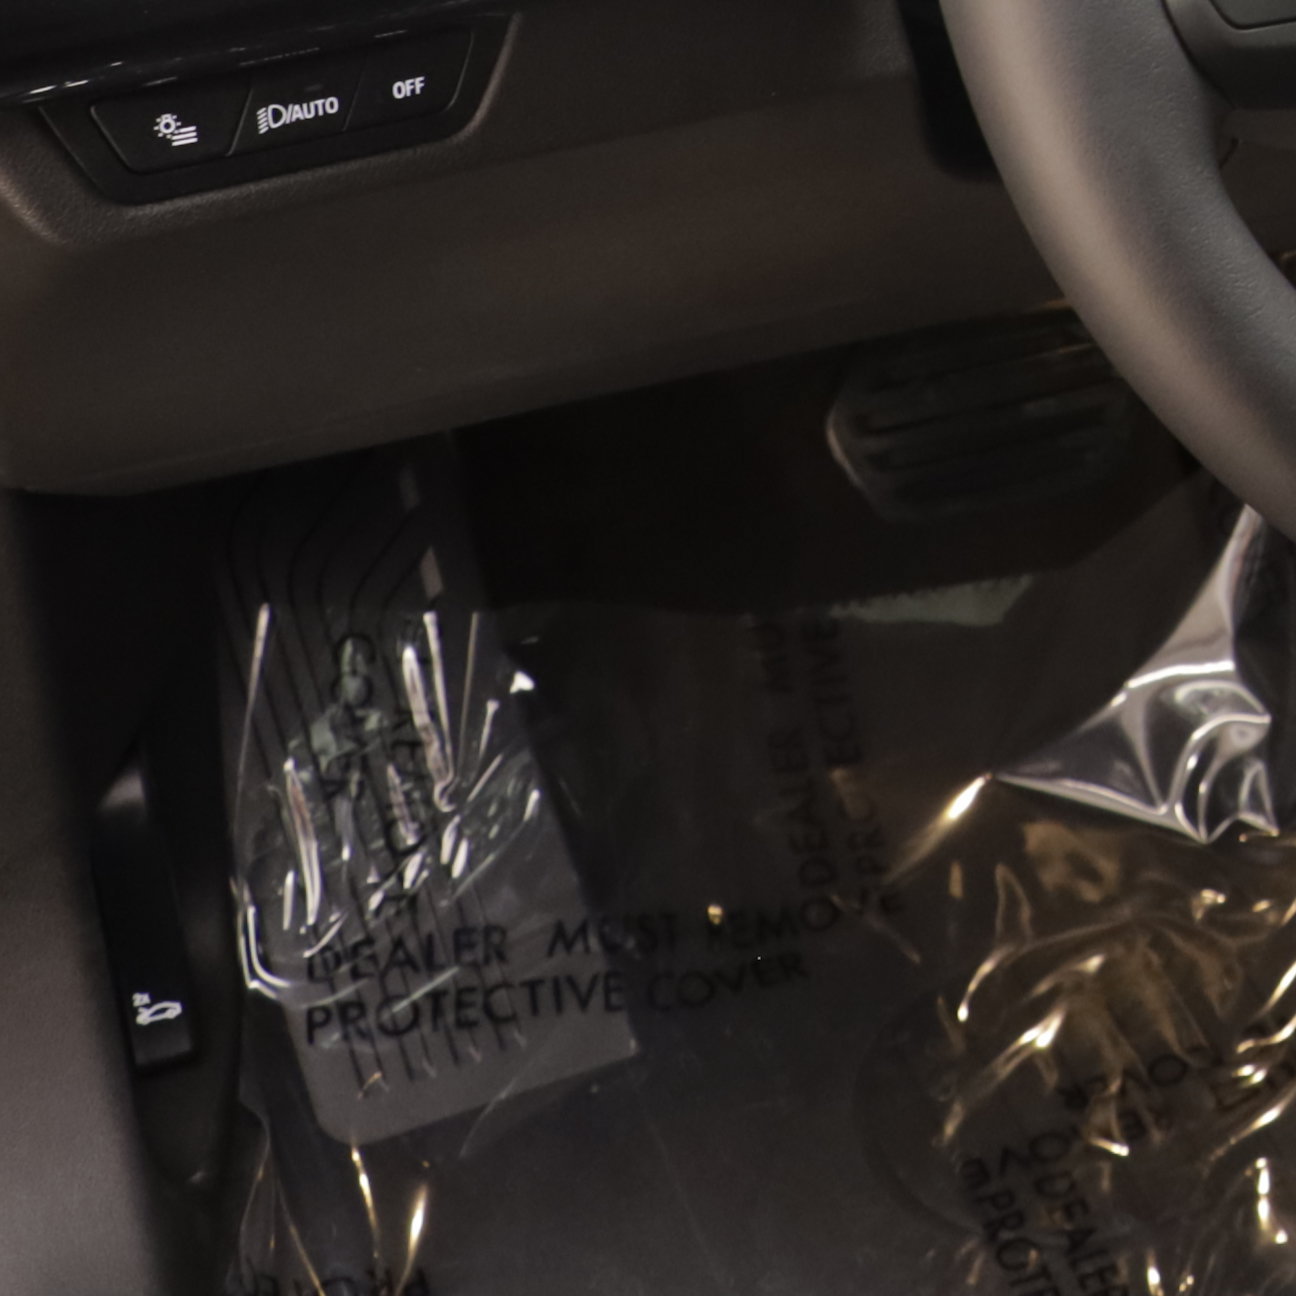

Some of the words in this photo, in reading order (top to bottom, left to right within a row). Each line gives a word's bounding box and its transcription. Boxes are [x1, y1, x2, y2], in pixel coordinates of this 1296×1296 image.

[392, 76, 425, 99] OFF
[306, 923, 508, 984] DEALER
[306, 970, 625, 1044] PROTECTIVE
[649, 951, 810, 1013] COVER
